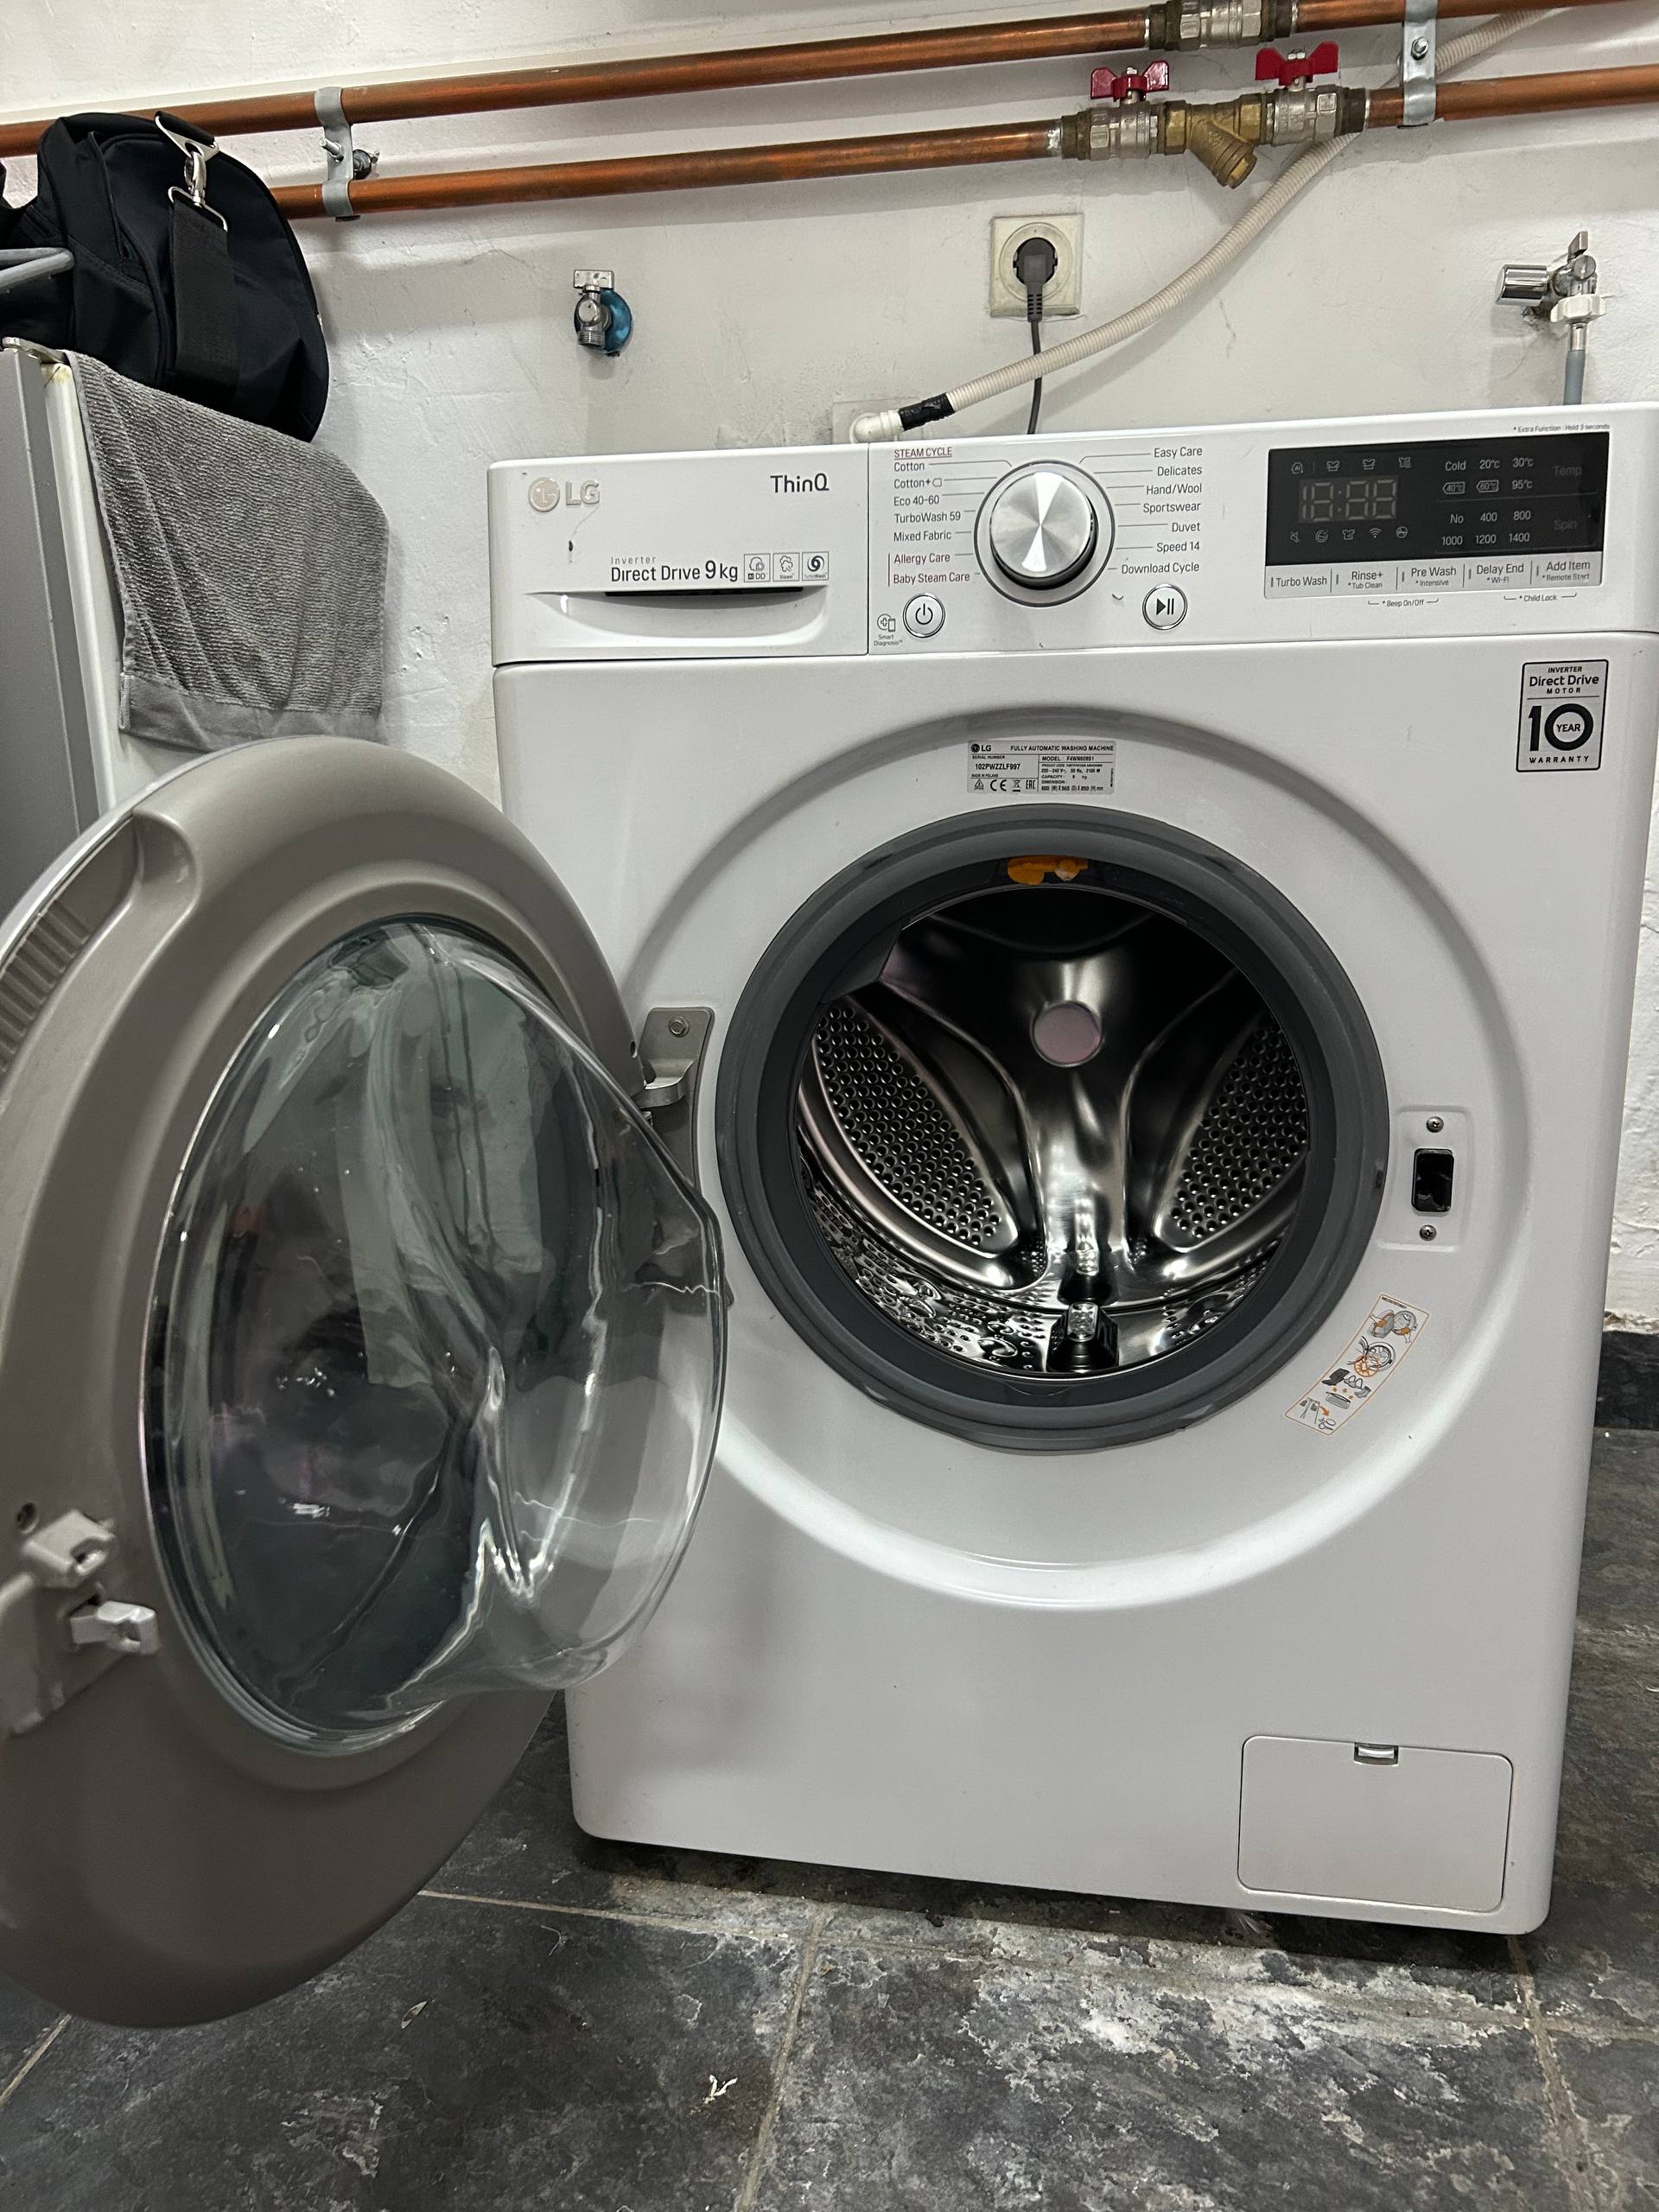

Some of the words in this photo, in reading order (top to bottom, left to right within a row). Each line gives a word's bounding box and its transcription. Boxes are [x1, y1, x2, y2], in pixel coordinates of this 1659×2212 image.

[894, 448, 924, 458] STEAM
[925, 447, 952, 456] CYCLE
[1154, 448, 1178, 459] Easy
[1179, 446, 1203, 456] Care
[893, 461, 925, 472] Cotton
[1157, 466, 1203, 476] Delicates
[1445, 461, 1466, 471] Cold
[1554, 465, 1582, 475] Temp
[770, 473, 830, 493] ThinQ
[1146, 483, 1203, 494] Hand/Wool
[565, 480, 600, 505] LG
[893, 496, 911, 506] Eco
[912, 494, 940, 505] 40-60
[1143, 502, 1202, 514] Sportswear
[893, 512, 948, 523] TurboWash
[949, 512, 961, 521] 59
[1450, 514, 1464, 524] No
[1480, 512, 1498, 522] 400
[1513, 510, 1531, 520] 800
[1172, 522, 1201, 532] Duvet
[1554, 519, 1578, 531] Spin
[893, 531, 921, 542] Mixed
[923, 530, 952, 540] Fabric
[1441, 536, 1463, 546] 1000
[1475, 534, 1497, 544] 1200
[1509, 532, 1530, 543] 1400
[1156, 542, 1187, 553] Speed
[1190, 541, 1200, 550] 14
[611, 556, 657, 565] Inverter
[893, 554, 927, 565] Allergy
[929, 553, 950, 563] Care
[611, 567, 657, 582] Direct
[661, 565, 701, 581] Drive
[705, 560, 716, 580] 9
[720, 563, 738, 582] kg
[1122, 563, 1170, 574] Download
[1173, 562, 1200, 574] Cycle
[1477, 564, 1504, 575] Delay
[1505, 563, 1524, 573] End
[1546, 561, 1567, 570] Add
[1568, 561, 1591, 569] Item
[1351, 570, 1383, 580] Rinse+
[1411, 568, 1427, 577] Pre
[1430, 567, 1457, 576] Wash
[893, 574, 916, 585] Baby
[918, 573, 947, 582] Steam
[949, 572, 970, 582] Care
[1275, 577, 1301, 587] Turbo
[1303, 575, 1327, 586] Wash
[1529, 676, 1565, 687] Direct
[1567, 675, 1599, 685] Drive
[1528, 703, 1594, 751] 10
[1556, 723, 1581, 732] YEAR
